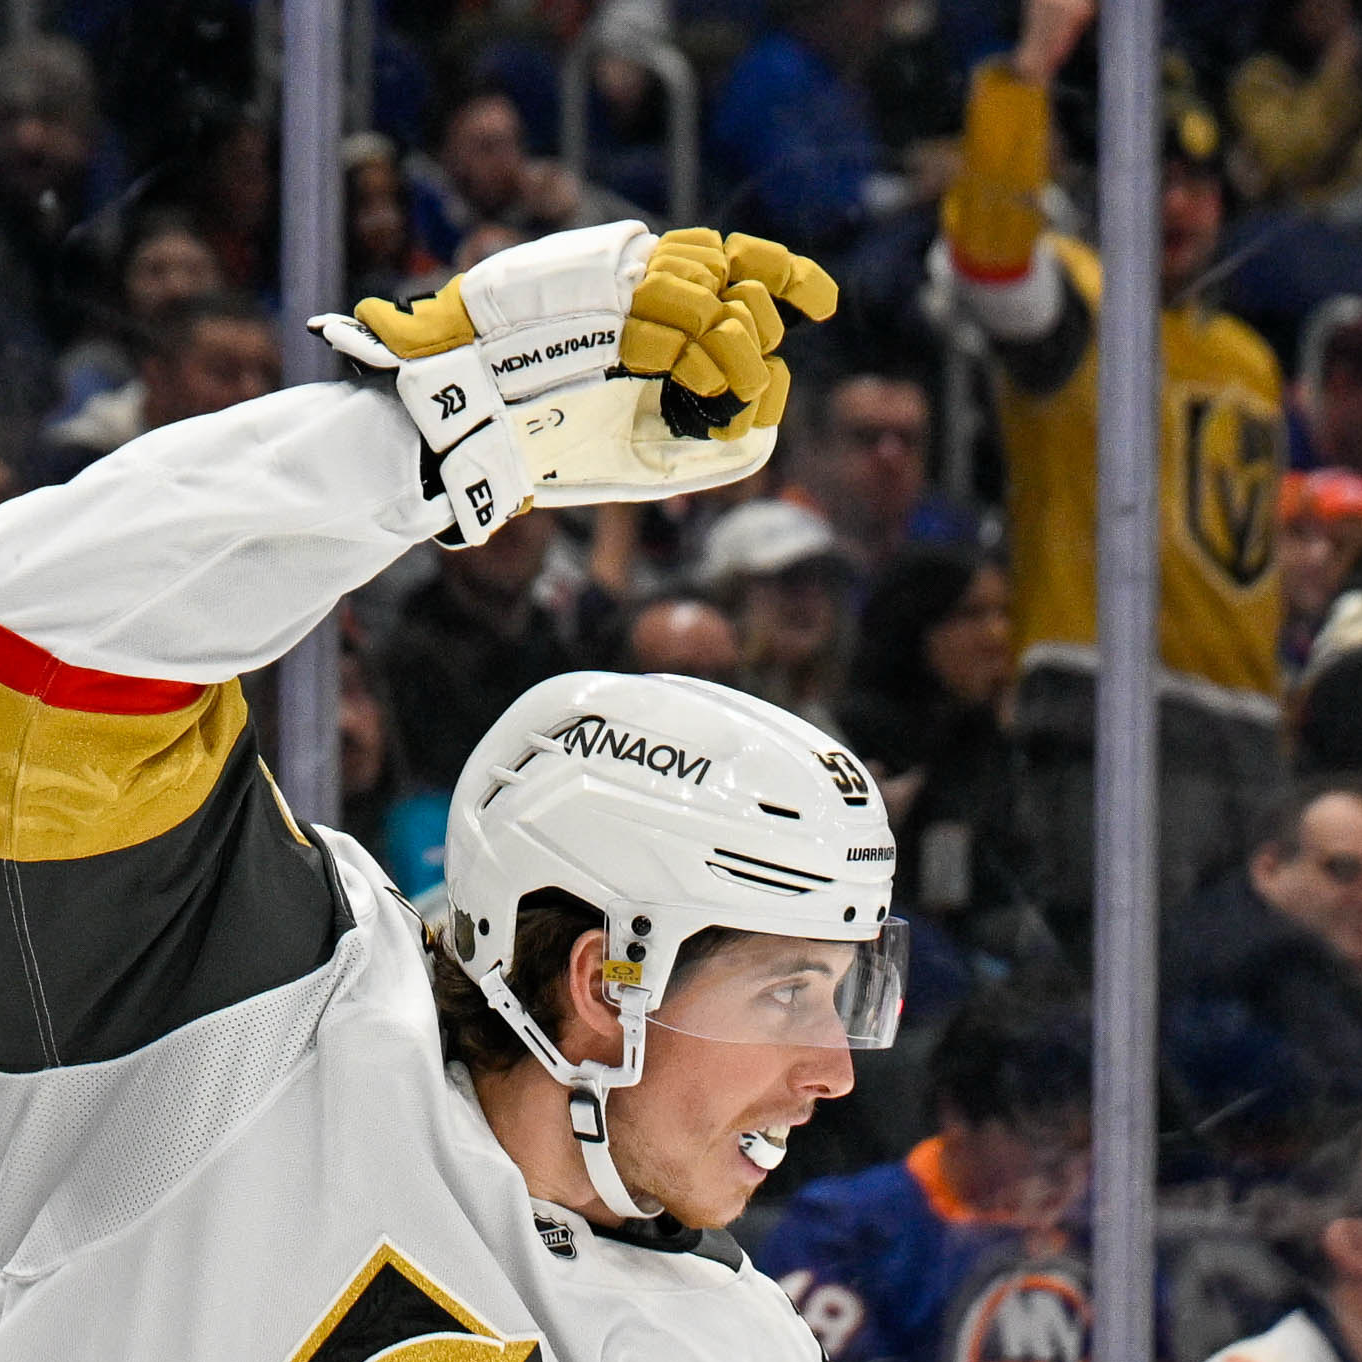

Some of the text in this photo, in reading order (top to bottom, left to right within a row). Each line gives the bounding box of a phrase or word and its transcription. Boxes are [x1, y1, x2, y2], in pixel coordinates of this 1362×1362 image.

[491, 330, 616, 377] MDM 05/04/25
[846, 846, 895, 862] WARRIOR
